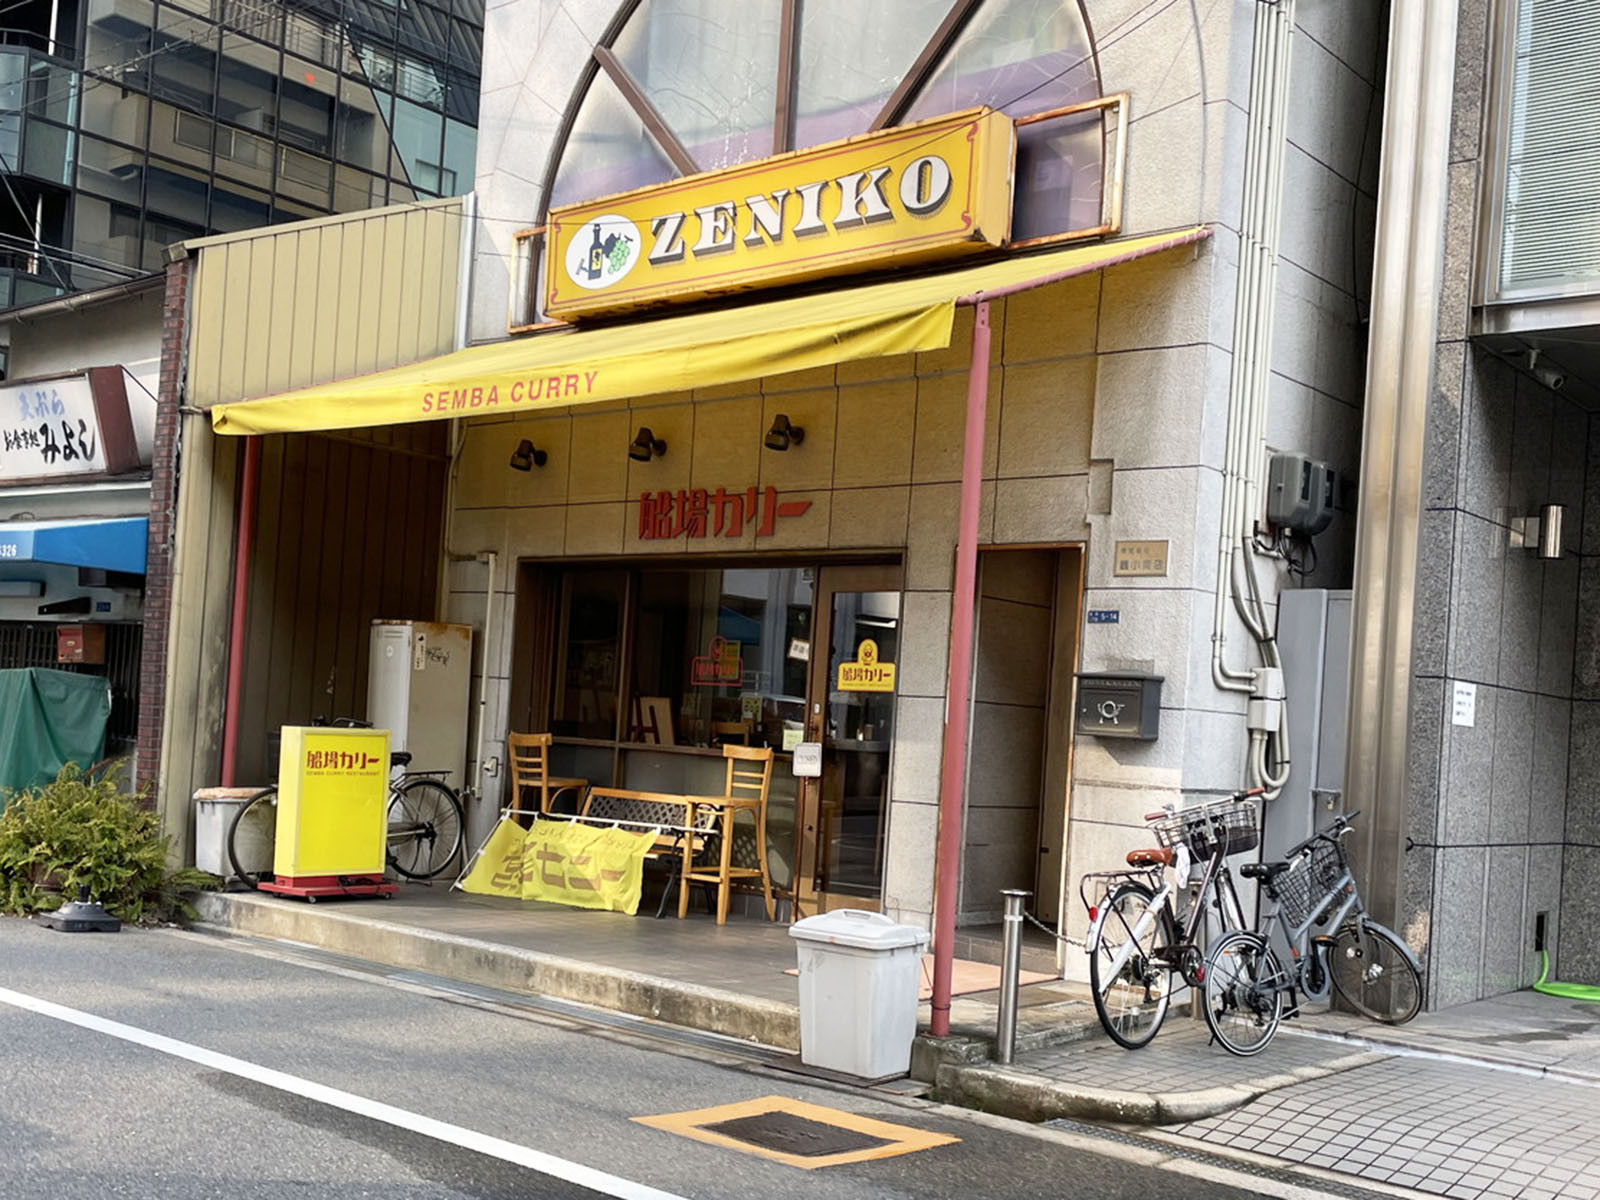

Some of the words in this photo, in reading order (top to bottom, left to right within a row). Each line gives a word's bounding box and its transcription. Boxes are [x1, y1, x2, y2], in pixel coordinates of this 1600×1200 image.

[648, 154, 953, 266] ZENIKO
[422, 384, 499, 413] SEMBA
[510, 370, 599, 404] CURRY
[638, 485, 813, 540] 船場カリー
[306, 750, 380, 769] 船場カリー
